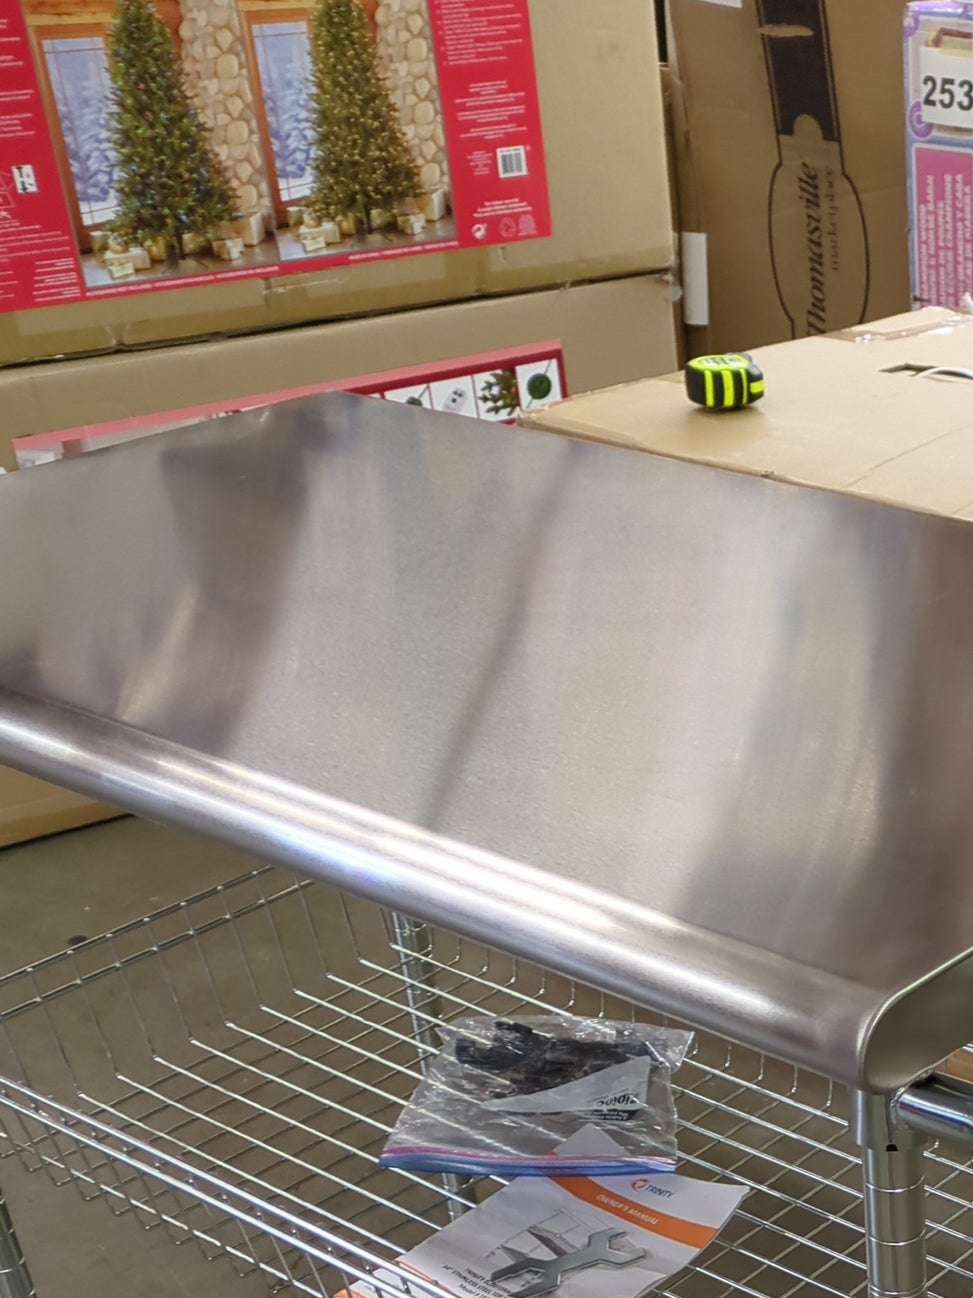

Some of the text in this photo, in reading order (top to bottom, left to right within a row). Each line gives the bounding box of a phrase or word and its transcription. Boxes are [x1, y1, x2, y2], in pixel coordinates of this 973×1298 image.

[926, 175, 934, 212] BARN
[955, 174, 963, 208] CASA
[823, 166, 840, 272] marketplace
[796, 162, 826, 338] Thomasville
[645, 1183, 676, 1199] TRINITY
[596, 1194, 660, 1226] OWNER'S MANUAL
[451, 1269, 478, 1288] STAINLESS
